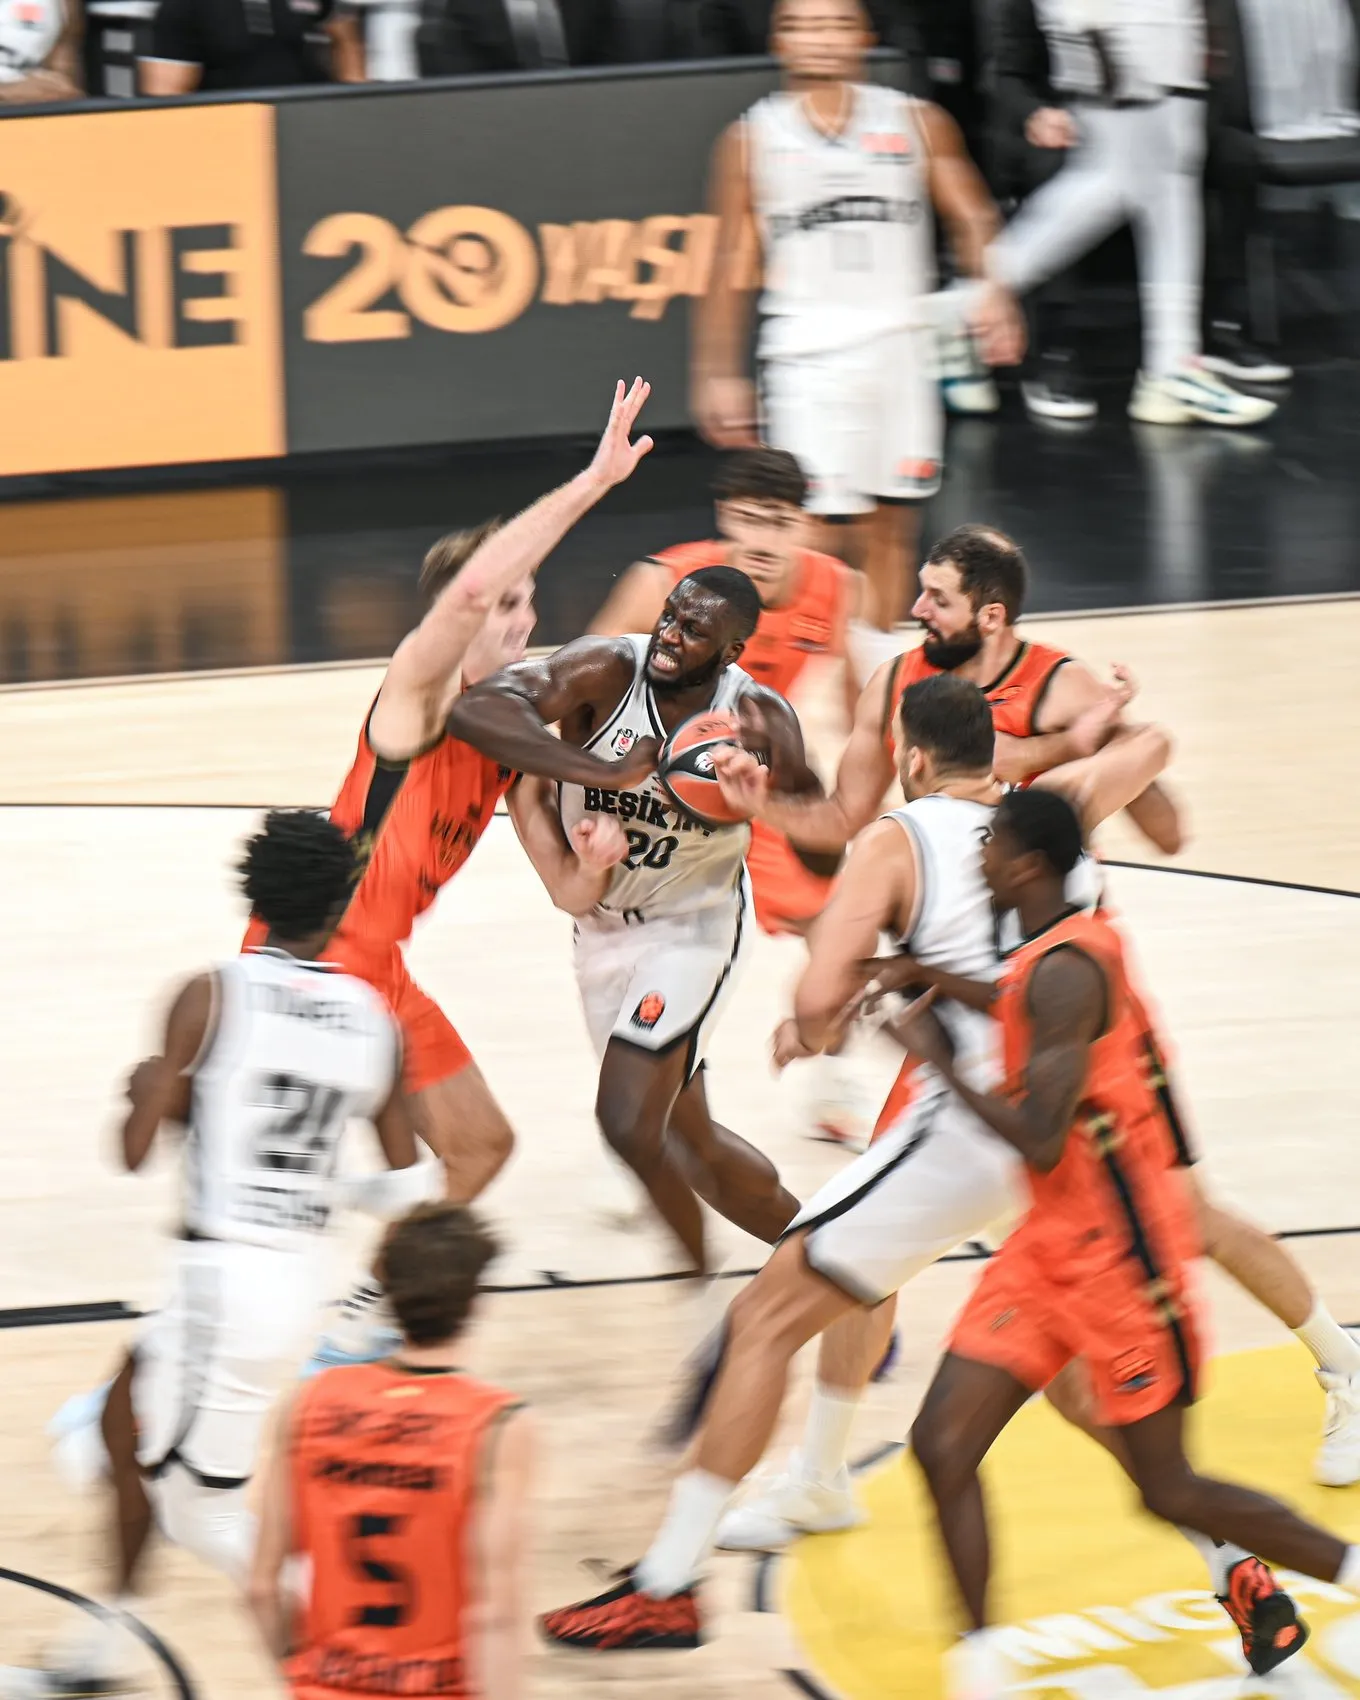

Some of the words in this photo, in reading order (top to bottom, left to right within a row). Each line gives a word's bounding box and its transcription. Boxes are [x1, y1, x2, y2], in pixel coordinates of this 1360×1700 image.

[584, 786, 714, 837] BEŞİK
[622, 828, 680, 871] 20
[344, 1513, 420, 1626] 5
